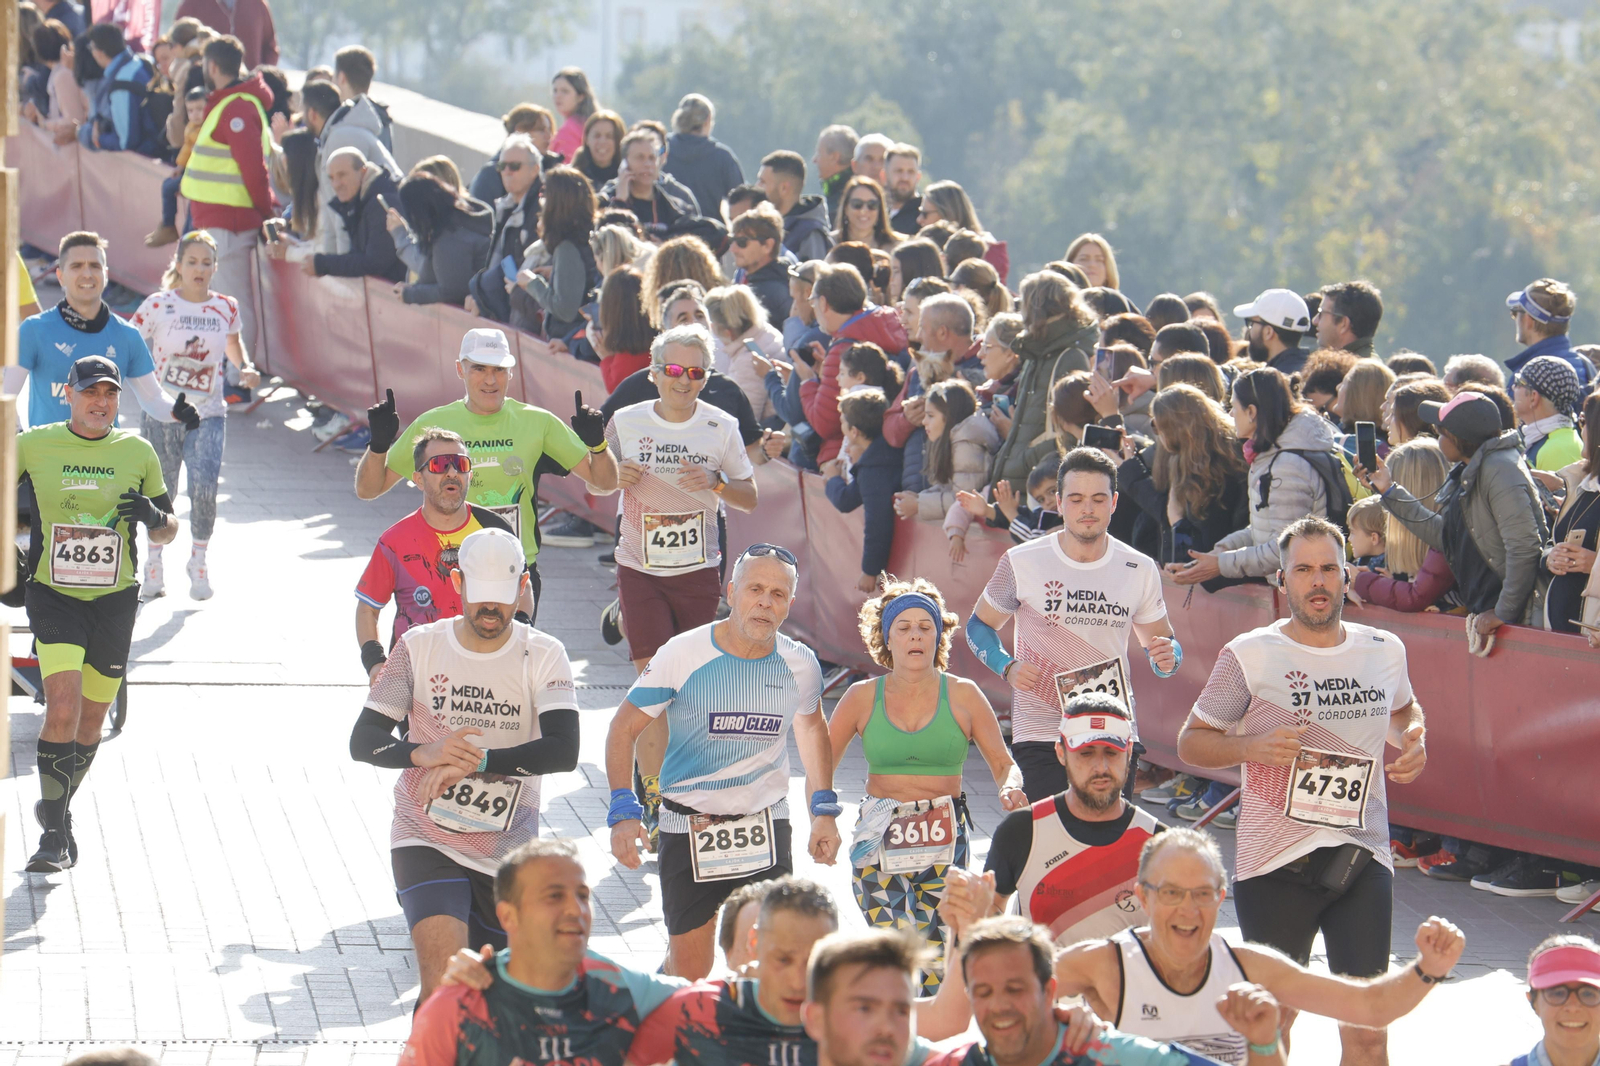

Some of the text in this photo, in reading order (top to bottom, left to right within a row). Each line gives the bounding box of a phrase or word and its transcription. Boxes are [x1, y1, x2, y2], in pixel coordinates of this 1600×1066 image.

[180, 316, 220, 326] GUERRERAS
[166, 366, 210, 390] 3543
[465, 438, 514, 448] RANING
[656, 444, 688, 454] MEDIA
[638, 452, 652, 462] 37
[62, 465, 115, 475] RANING
[654, 465, 690, 474] CÓRD
[651, 528, 698, 548] 4213
[56, 544, 114, 564] 4863
[1067, 590, 1108, 602] MEDIA
[1044, 600, 1062, 612] 37
[1066, 602, 1130, 618] MARATÓN
[1064, 616, 1108, 626] CÓRDOBA
[451, 684, 494, 700] MEDIA
[1314, 678, 1362, 692] MEDIA
[432, 696, 446, 710] 37
[1291, 692, 1312, 706] 37
[1316, 686, 1386, 706] MARATÓN
[450, 700, 521, 716] MARATÓN
[1318, 706, 1388, 720] CÓRDOBA 2023
[450, 715, 520, 730] CÓRDOBA 2023
[712, 716, 782, 732] EURO CLEAN
[1296, 772, 1362, 802] 4738
[440, 784, 508, 818] 3849
[698, 825, 766, 853] 2858
[889, 820, 946, 845] 3616
